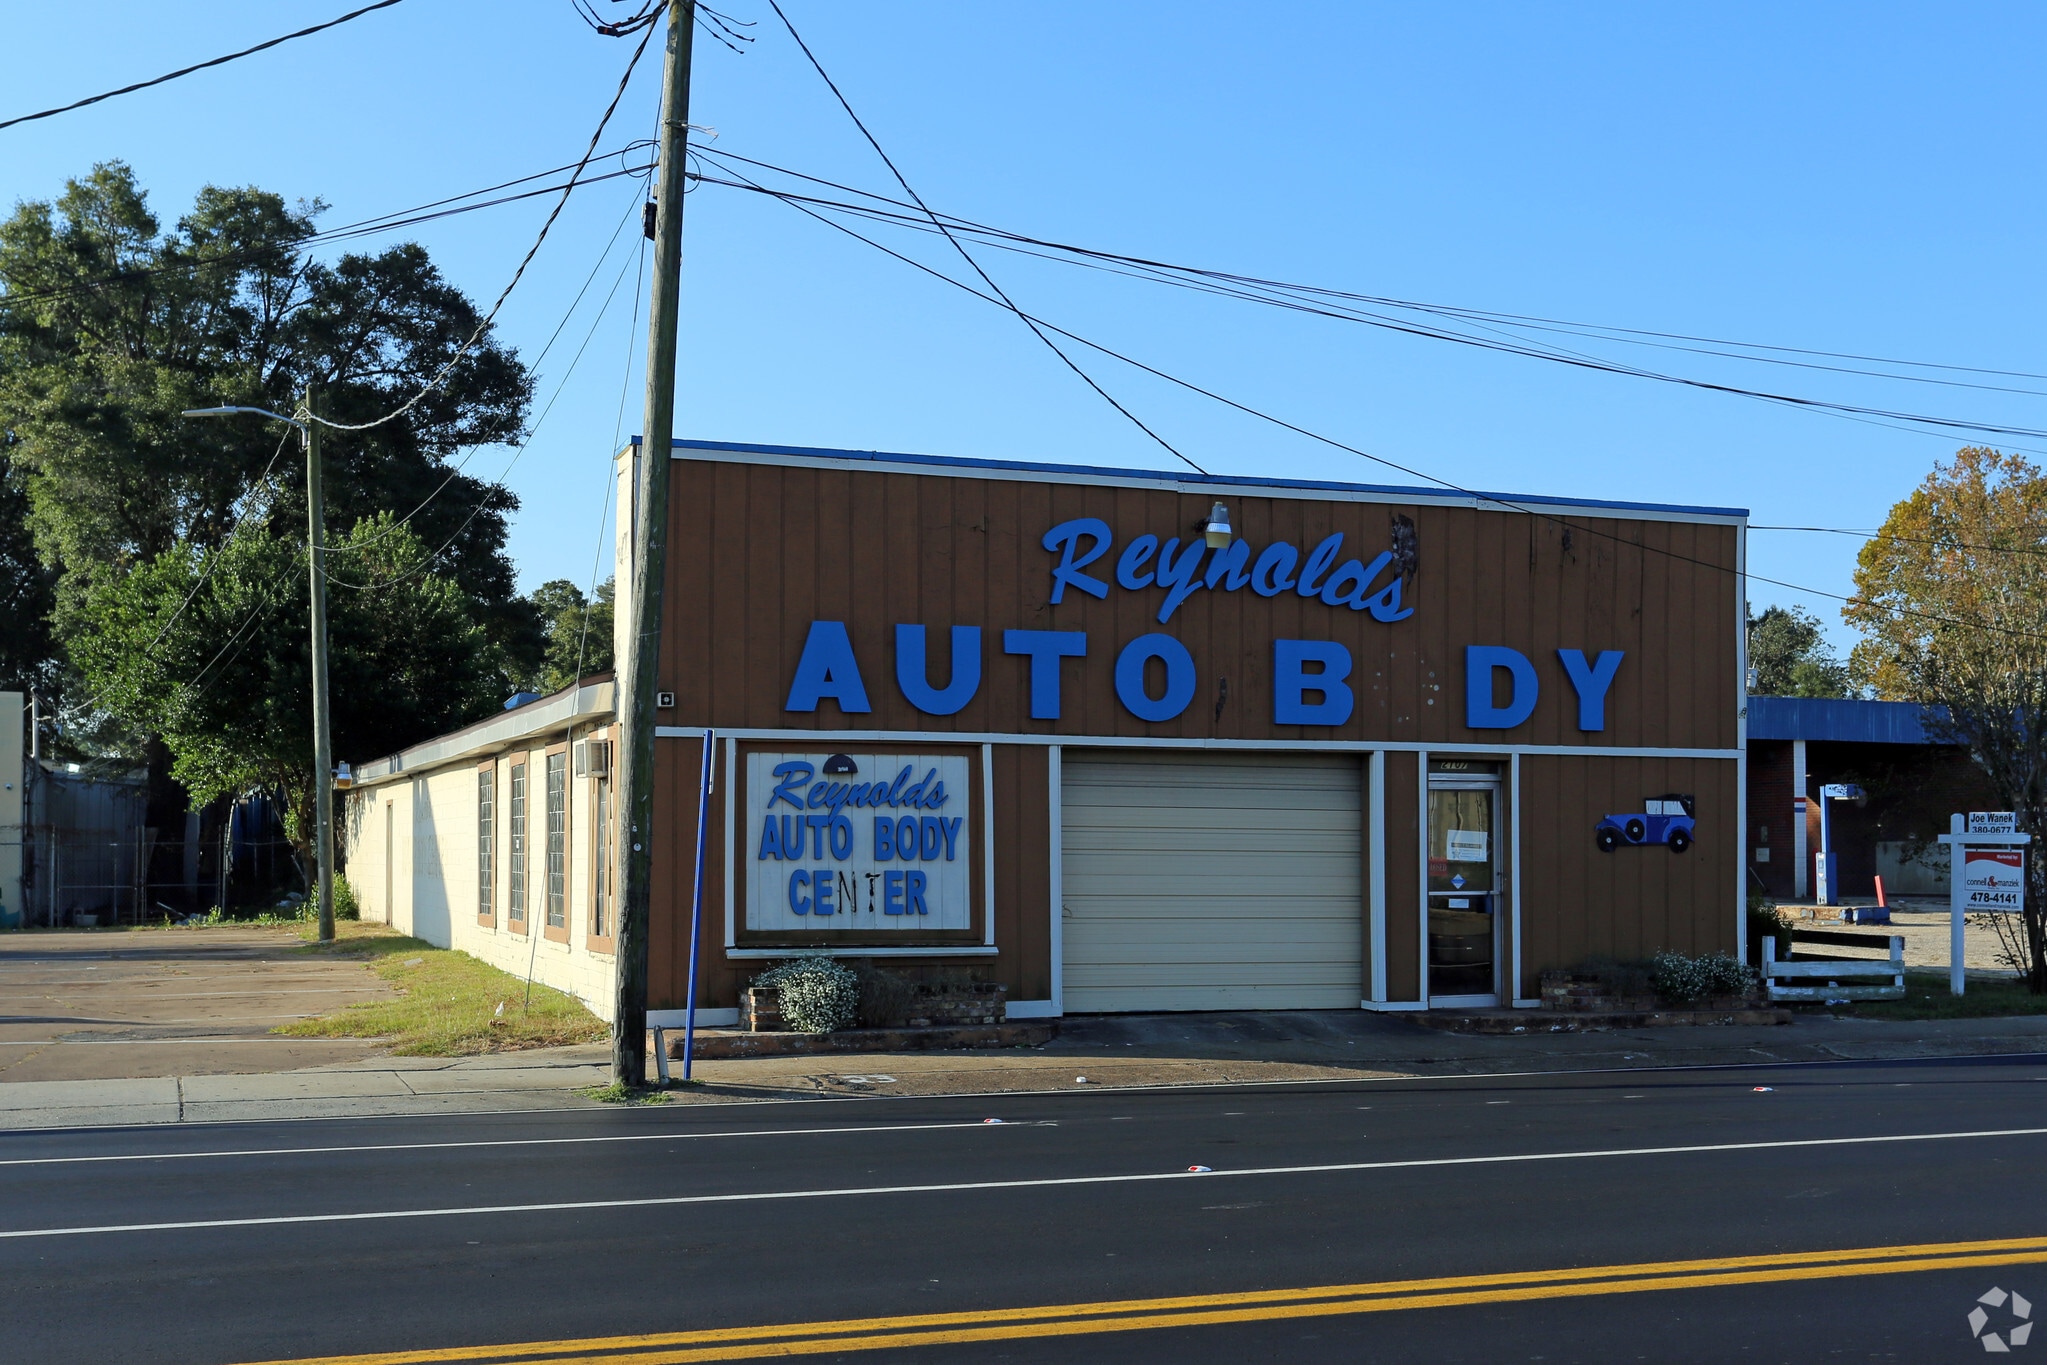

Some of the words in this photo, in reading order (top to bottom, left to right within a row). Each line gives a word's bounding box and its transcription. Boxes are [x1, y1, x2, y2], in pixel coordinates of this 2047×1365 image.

[1041, 517, 1414, 624] Reynolds
[784, 620, 1197, 723] AUTO
[1274, 639, 1625, 731] BDY
[767, 760, 949, 826] Reynolds
[758, 814, 853, 861] AUTO
[874, 816, 963, 861] BODY
[1970, 814, 1985, 823] Joe
[1987, 813, 2013, 823] Wanek
[1972, 826, 2011, 834] 380-0677
[788, 868, 928, 915] CENTER
[1967, 878, 1986, 887] connell
[1987, 876, 1998, 887] &
[1970, 892, 2017, 904] 478-4141
